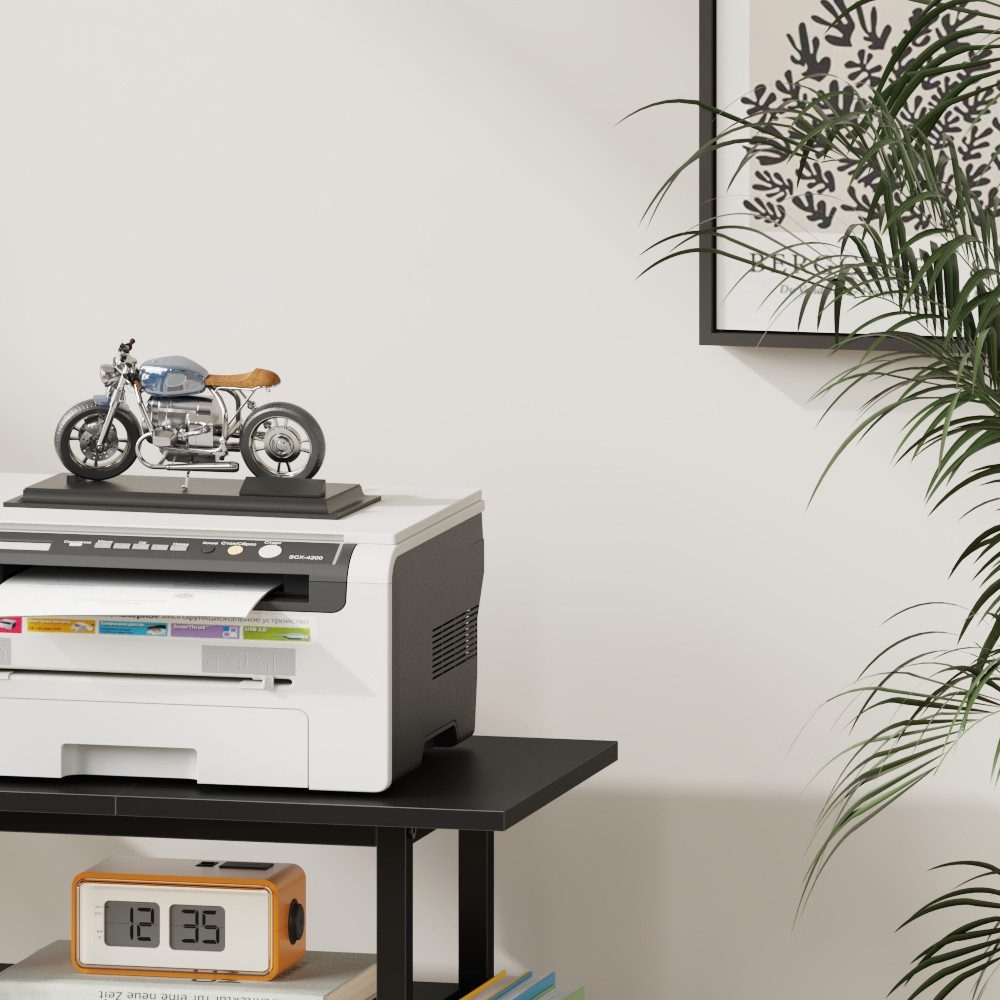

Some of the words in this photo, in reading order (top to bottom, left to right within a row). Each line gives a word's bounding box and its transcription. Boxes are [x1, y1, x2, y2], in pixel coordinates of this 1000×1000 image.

[129, 907, 155, 942] 12
[181, 909, 220, 944] 35
[98, 990, 123, 1000] Zeit
[126, 992, 157, 1000] neue
